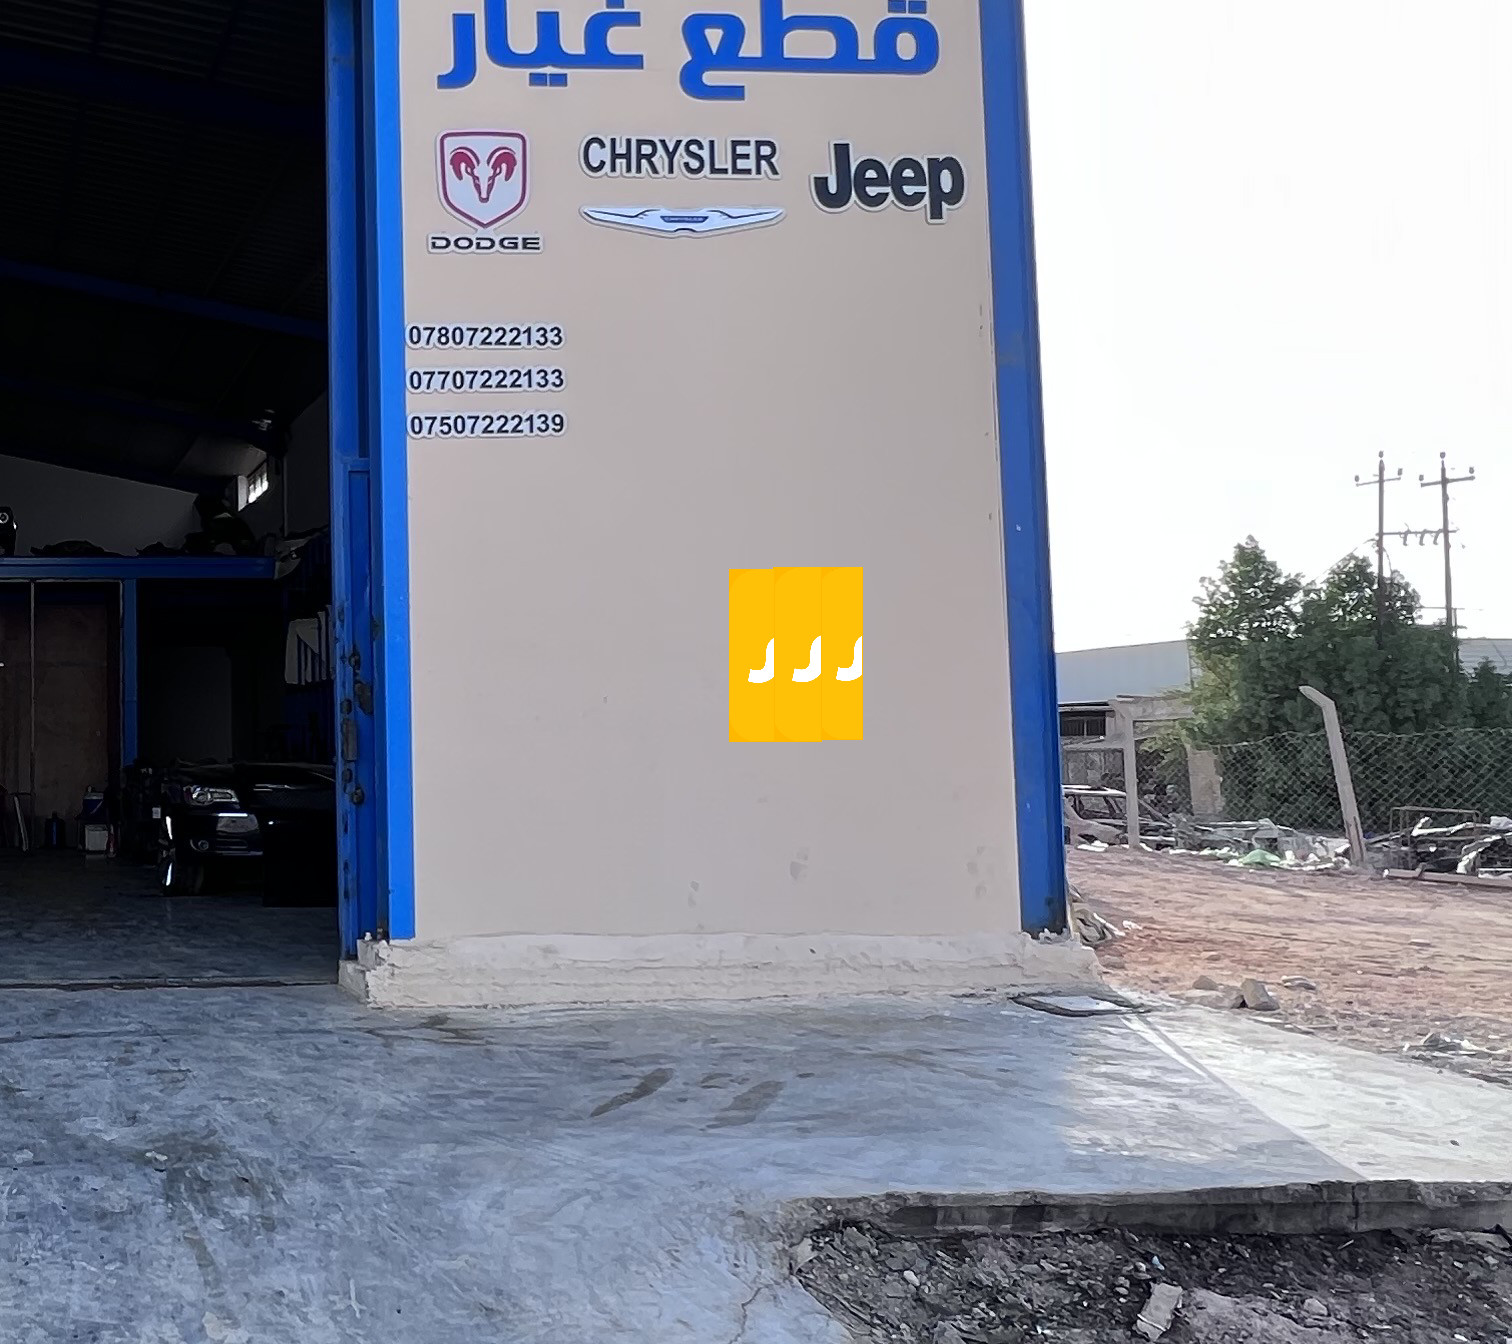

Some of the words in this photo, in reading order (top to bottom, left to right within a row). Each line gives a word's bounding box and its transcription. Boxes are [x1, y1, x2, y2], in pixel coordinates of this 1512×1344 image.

[583, 137, 779, 176] CHRYSLER
[813, 143, 965, 220] Jeep
[431, 236, 541, 251] DODGE
[408, 325, 564, 347] 07807222133
[409, 368, 565, 390] 07707222133
[410, 413, 565, 435] 07507222139
